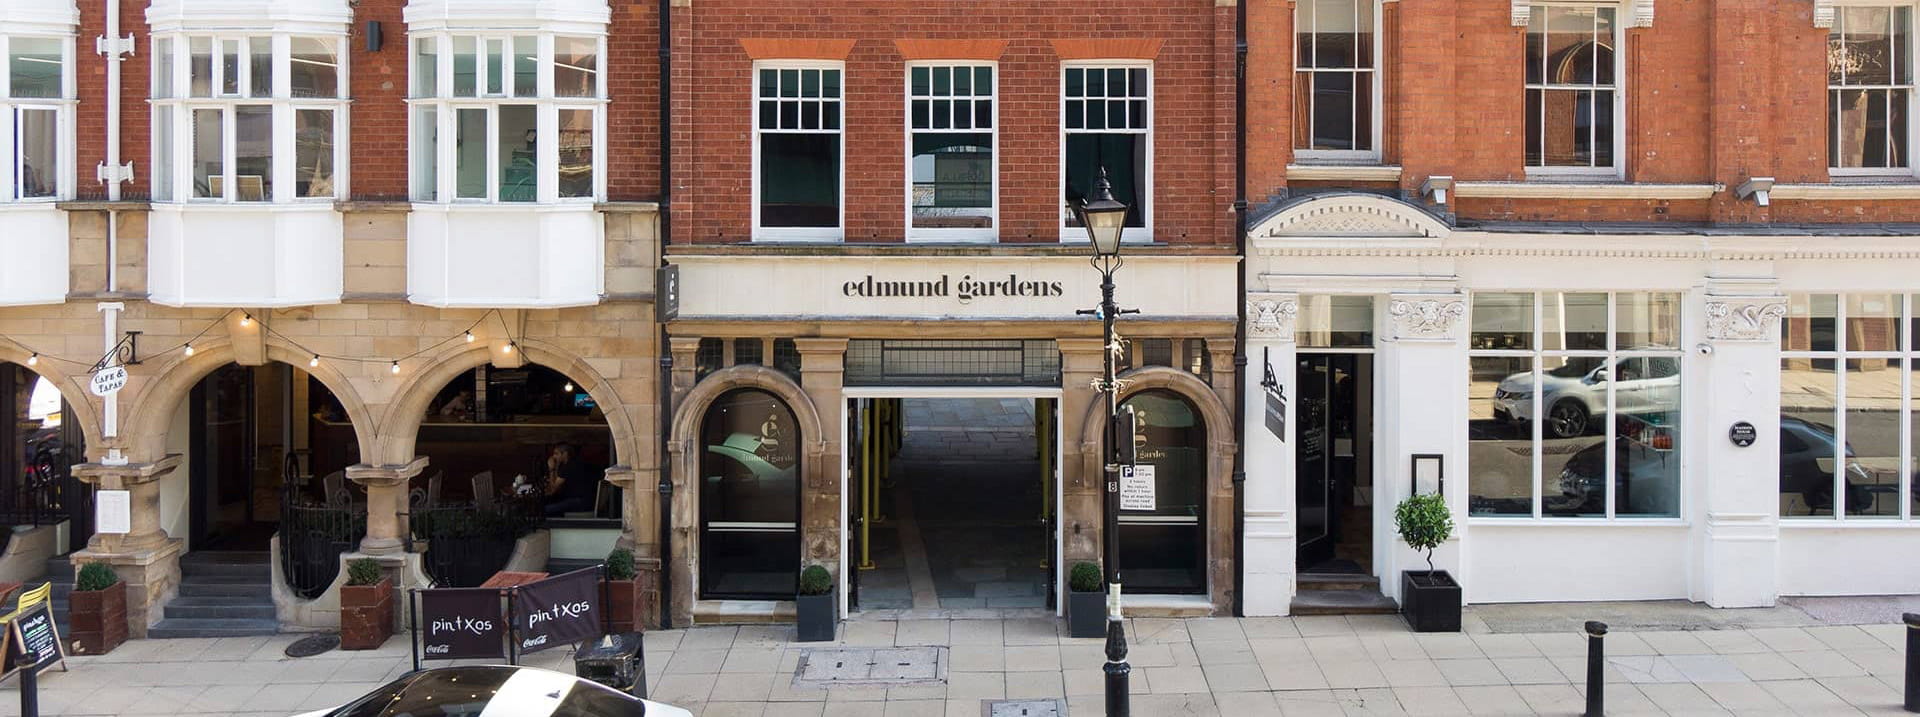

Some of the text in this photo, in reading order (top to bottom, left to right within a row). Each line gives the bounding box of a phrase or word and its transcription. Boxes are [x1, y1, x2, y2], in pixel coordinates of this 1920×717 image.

[842, 274, 1063, 304] edmund gardens
[1124, 467, 1133, 477] P
[432, 616, 492, 635] pintxos
[529, 600, 590, 629] pintxos
